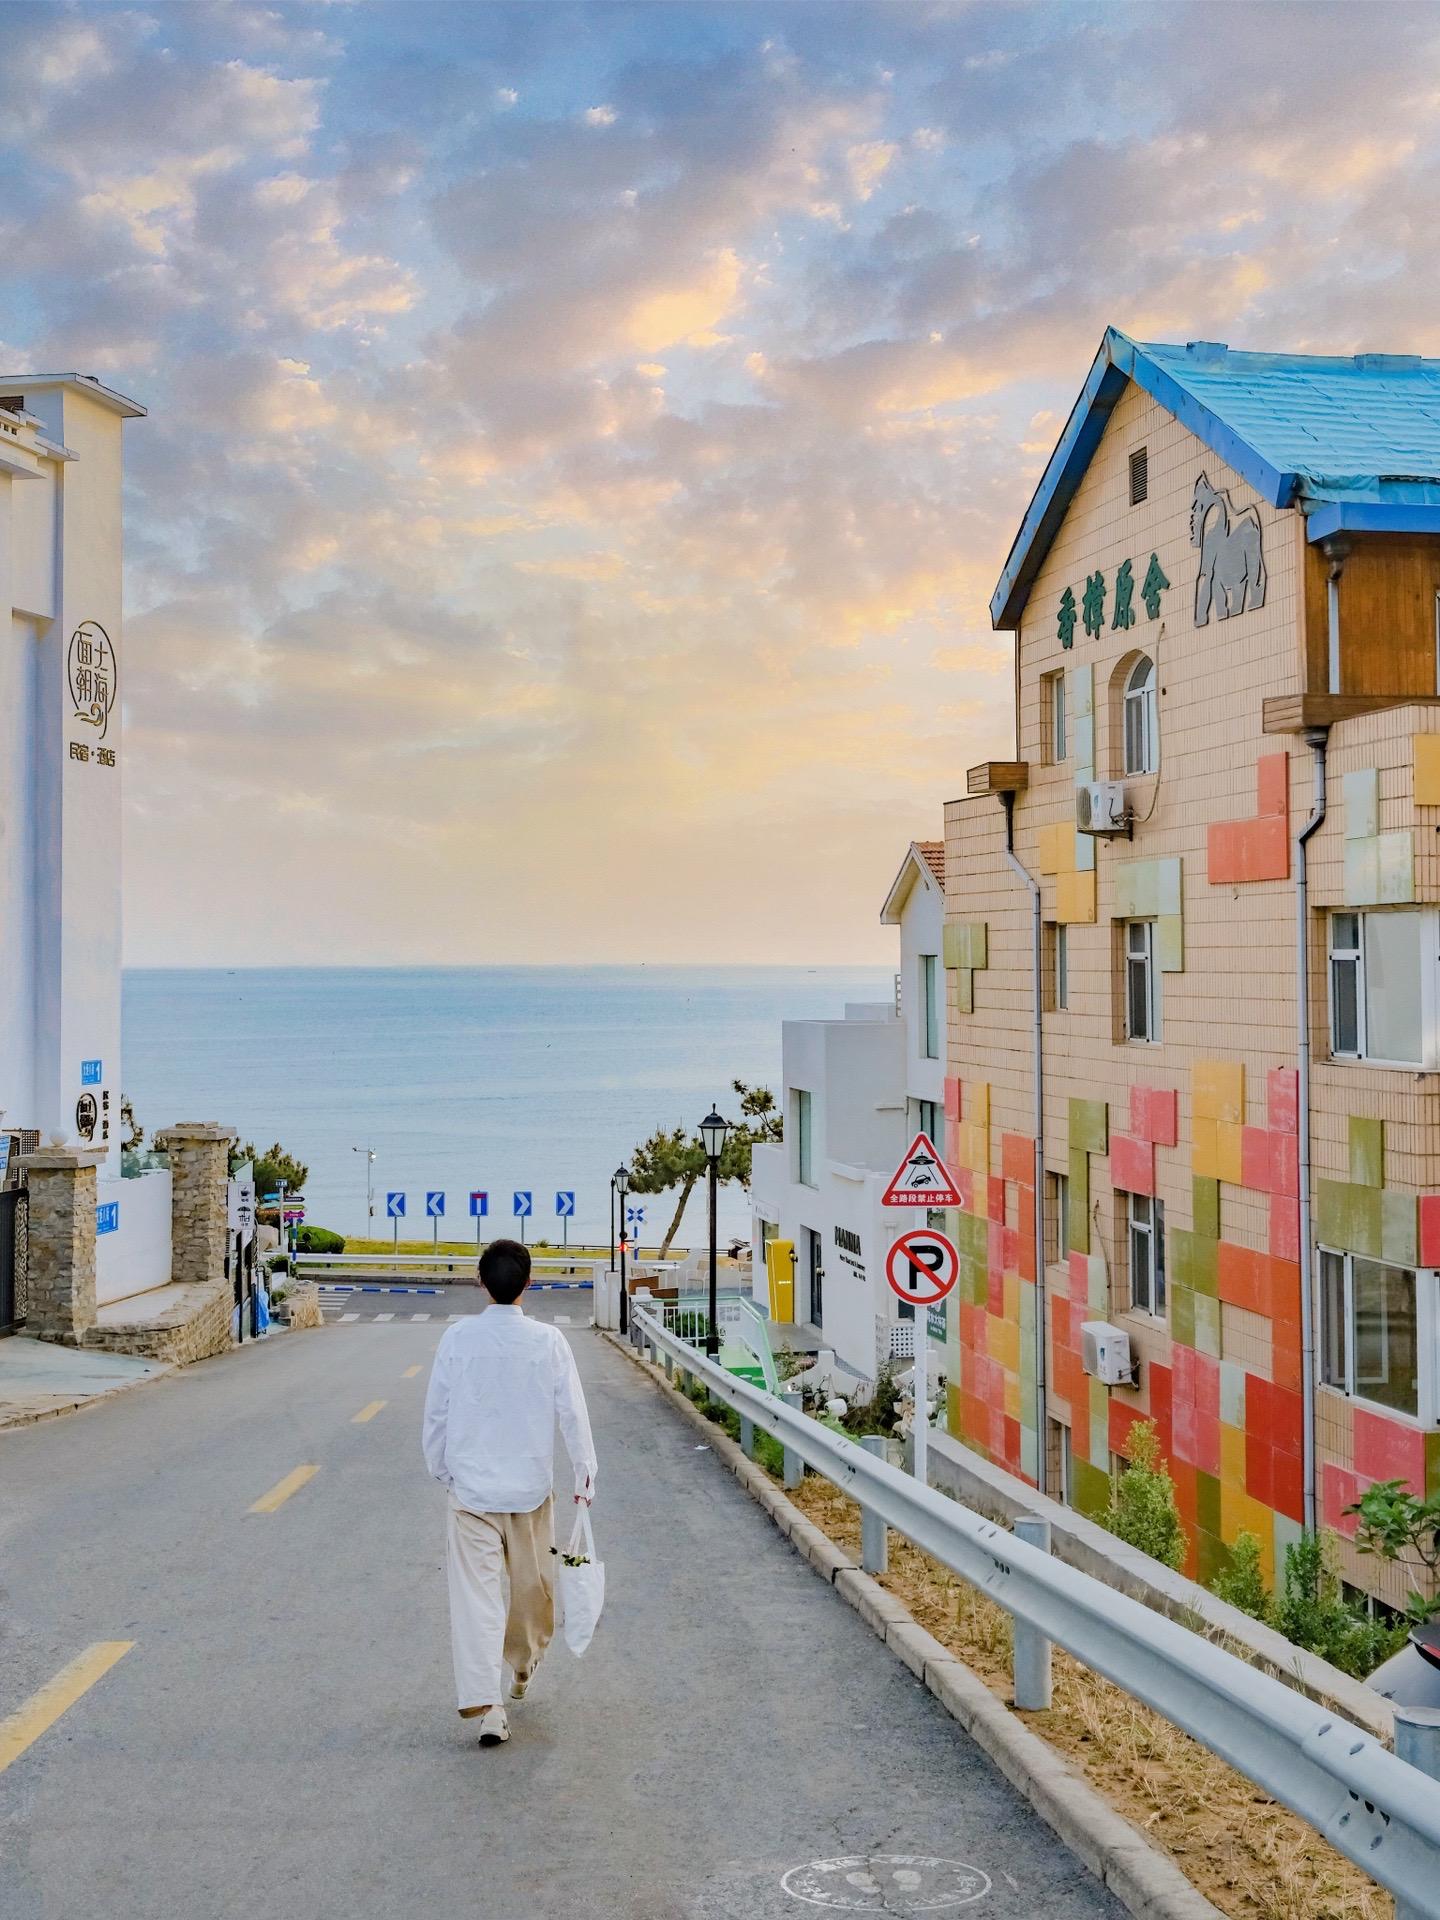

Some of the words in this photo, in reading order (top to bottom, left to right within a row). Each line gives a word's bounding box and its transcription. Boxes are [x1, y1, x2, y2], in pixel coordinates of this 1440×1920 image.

[889, 1193, 953, 1203] 全路段禁止停车
[909, 1245, 944, 1290] P
